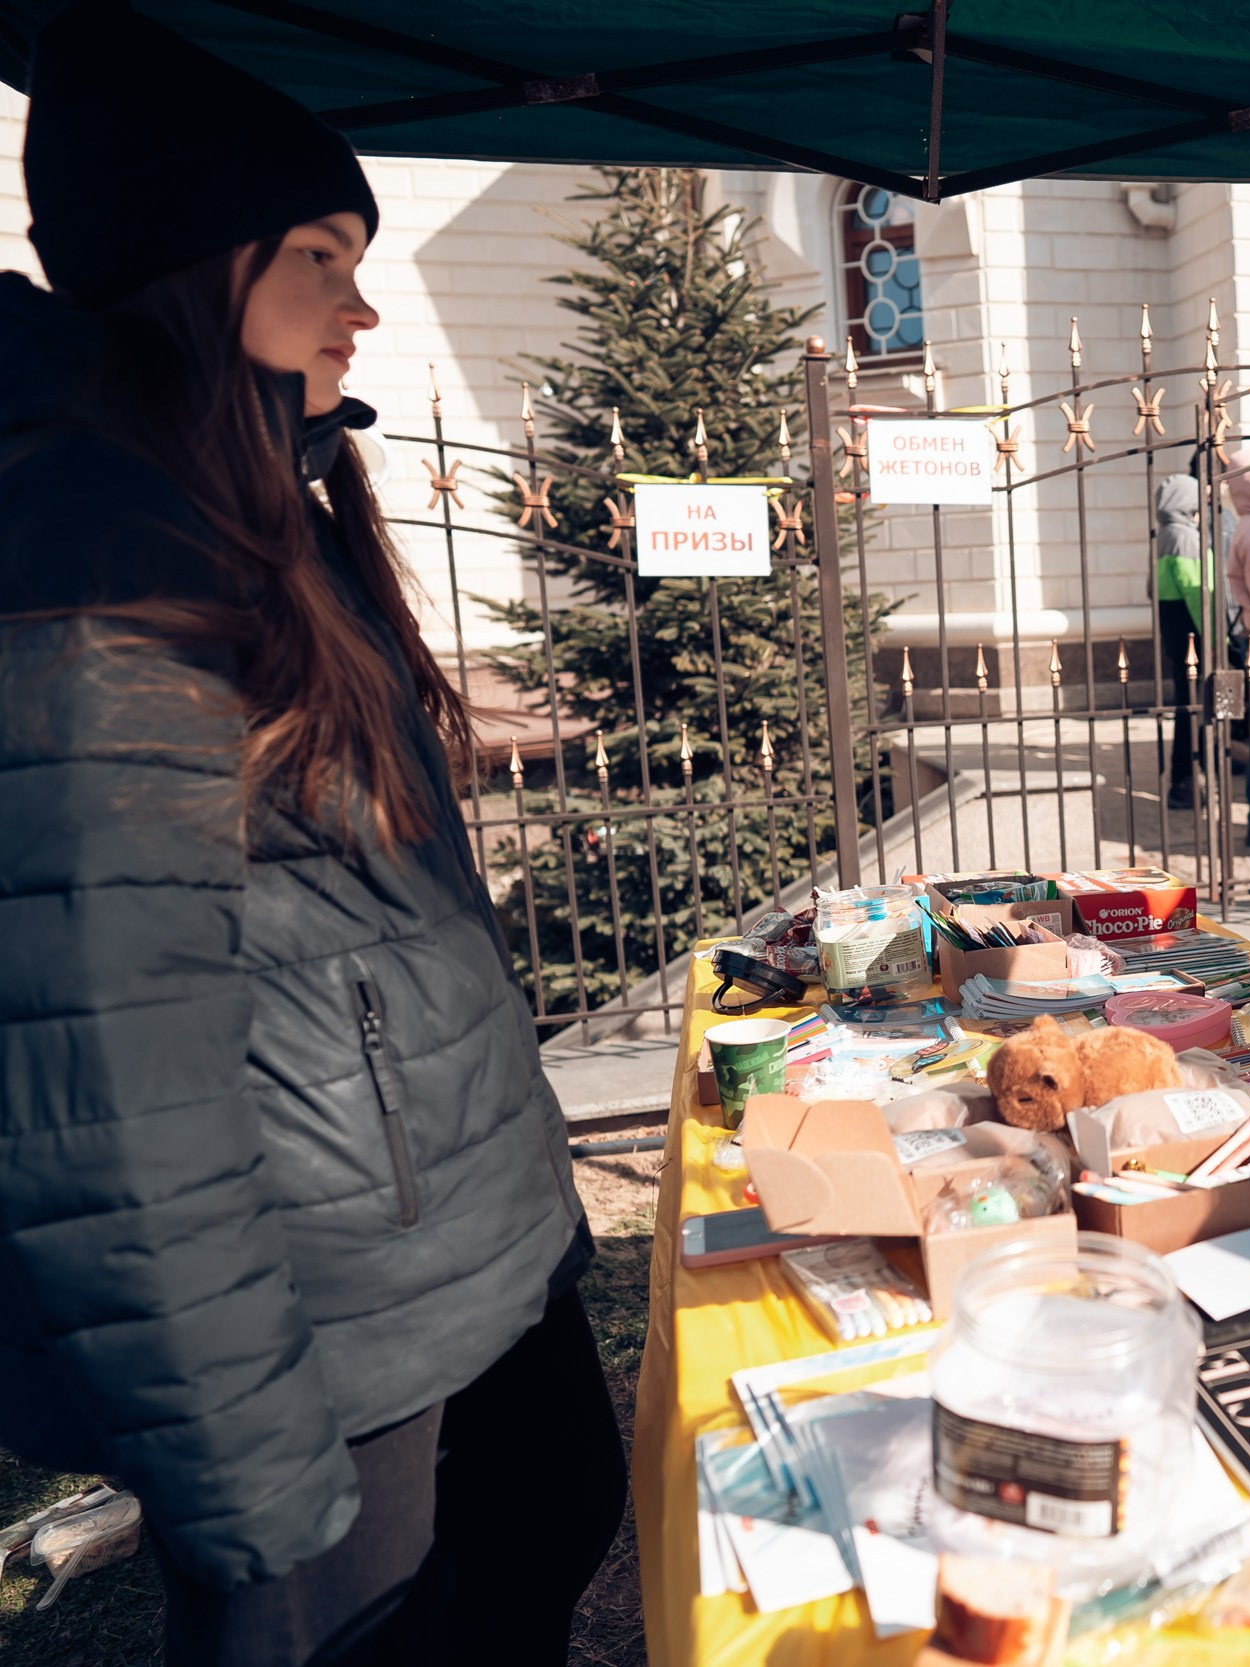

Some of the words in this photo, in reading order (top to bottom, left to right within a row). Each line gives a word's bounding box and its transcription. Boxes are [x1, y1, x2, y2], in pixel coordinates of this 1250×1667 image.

[893, 436, 964, 452] ОБМЕН
[879, 460, 981, 476] ЖЕТОНОВ
[687, 505, 717, 520] НА
[651, 531, 753, 552] ПРИЗЫ
[1110, 907, 1142, 917] ORION
